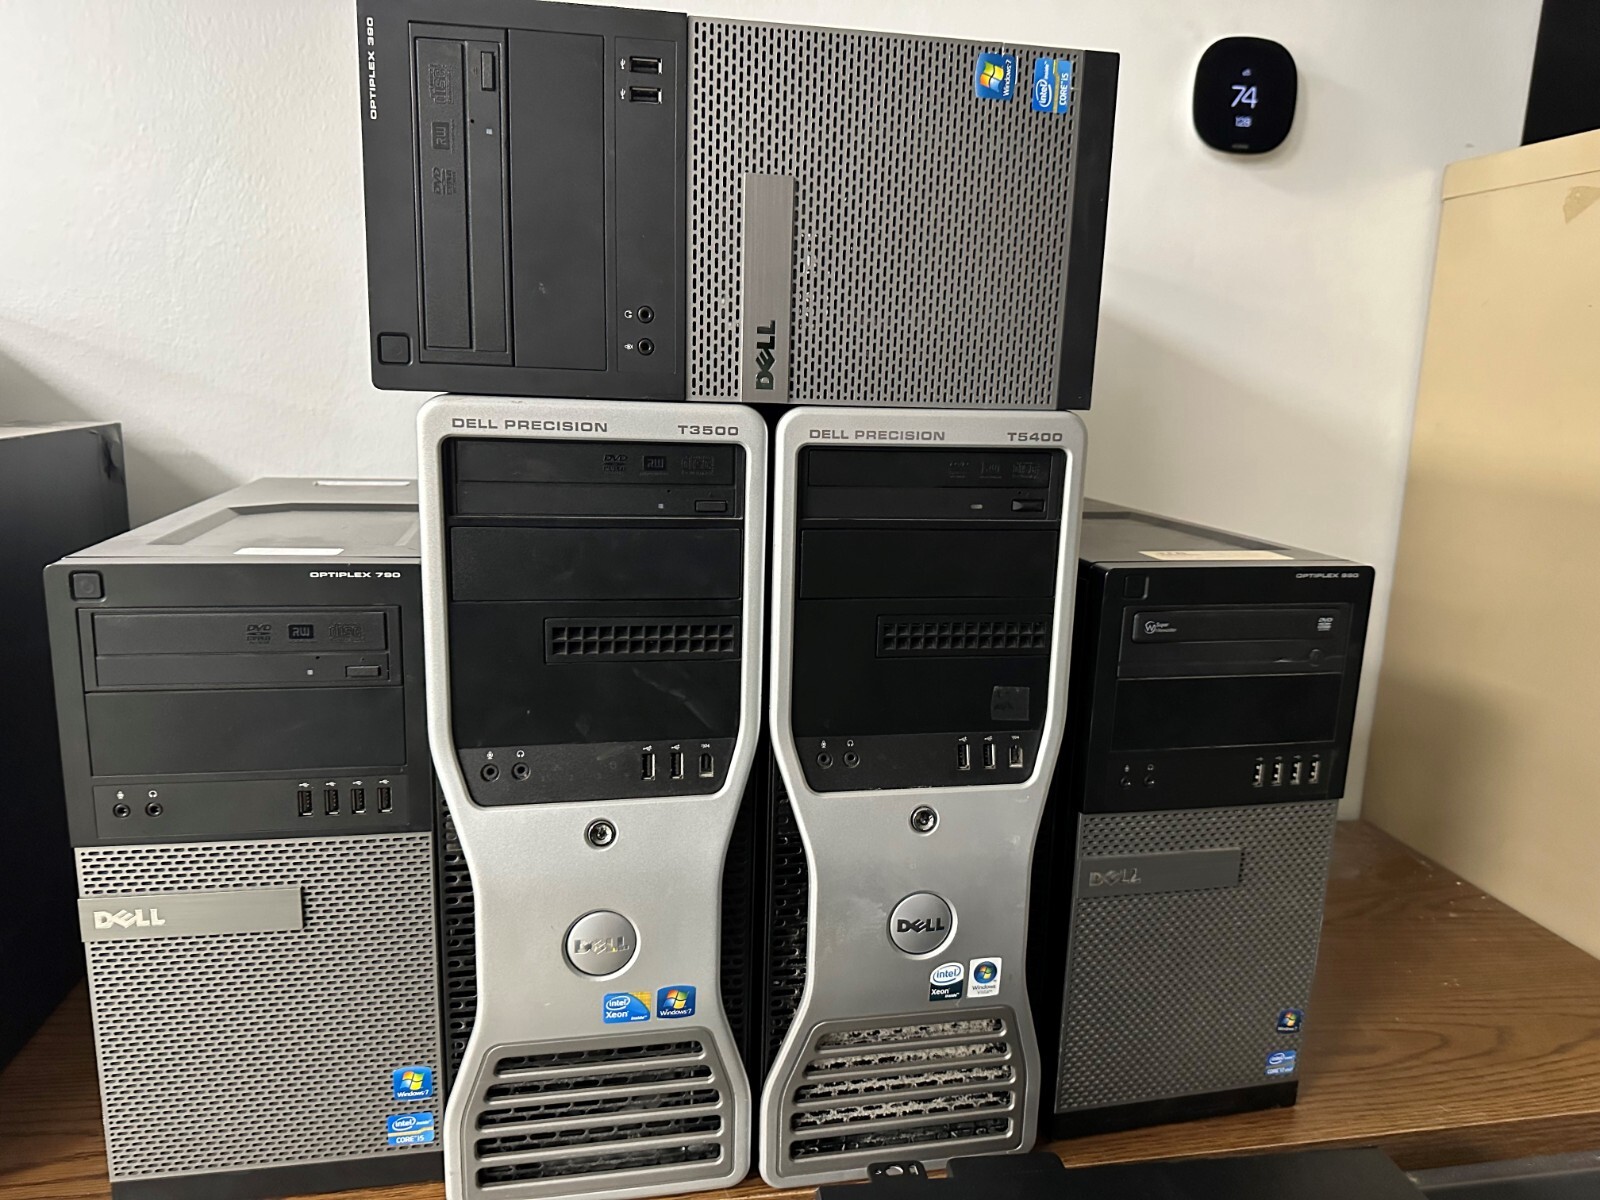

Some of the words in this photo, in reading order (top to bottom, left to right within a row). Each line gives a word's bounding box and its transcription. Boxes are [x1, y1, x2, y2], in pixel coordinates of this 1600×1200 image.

[366, 17, 375, 46] 390
[367, 51, 377, 120] OPTIPLEX
[1003, 67, 1012, 97] Windows
[1059, 81, 1068, 106] CORE
[1231, 85, 1258, 109] 74
[755, 319, 776, 390] DELL
[452, 417, 498, 429] DELL
[504, 419, 608, 433] PRECISION
[677, 424, 739, 436] T3500
[809, 429, 849, 440] DELL
[855, 430, 945, 441] PRECISION
[1007, 432, 1063, 442] T5400
[1088, 867, 1142, 887] DELL
[93, 908, 166, 930] DELL
[896, 917, 945, 933] DELL
[573, 936, 630, 955] DELL
[936, 968, 958, 979] intel
[931, 988, 950, 996] Xeon
[605, 1010, 629, 1019] Xeon
[397, 1090, 424, 1098] Windows
[395, 1136, 415, 1144] CORE
